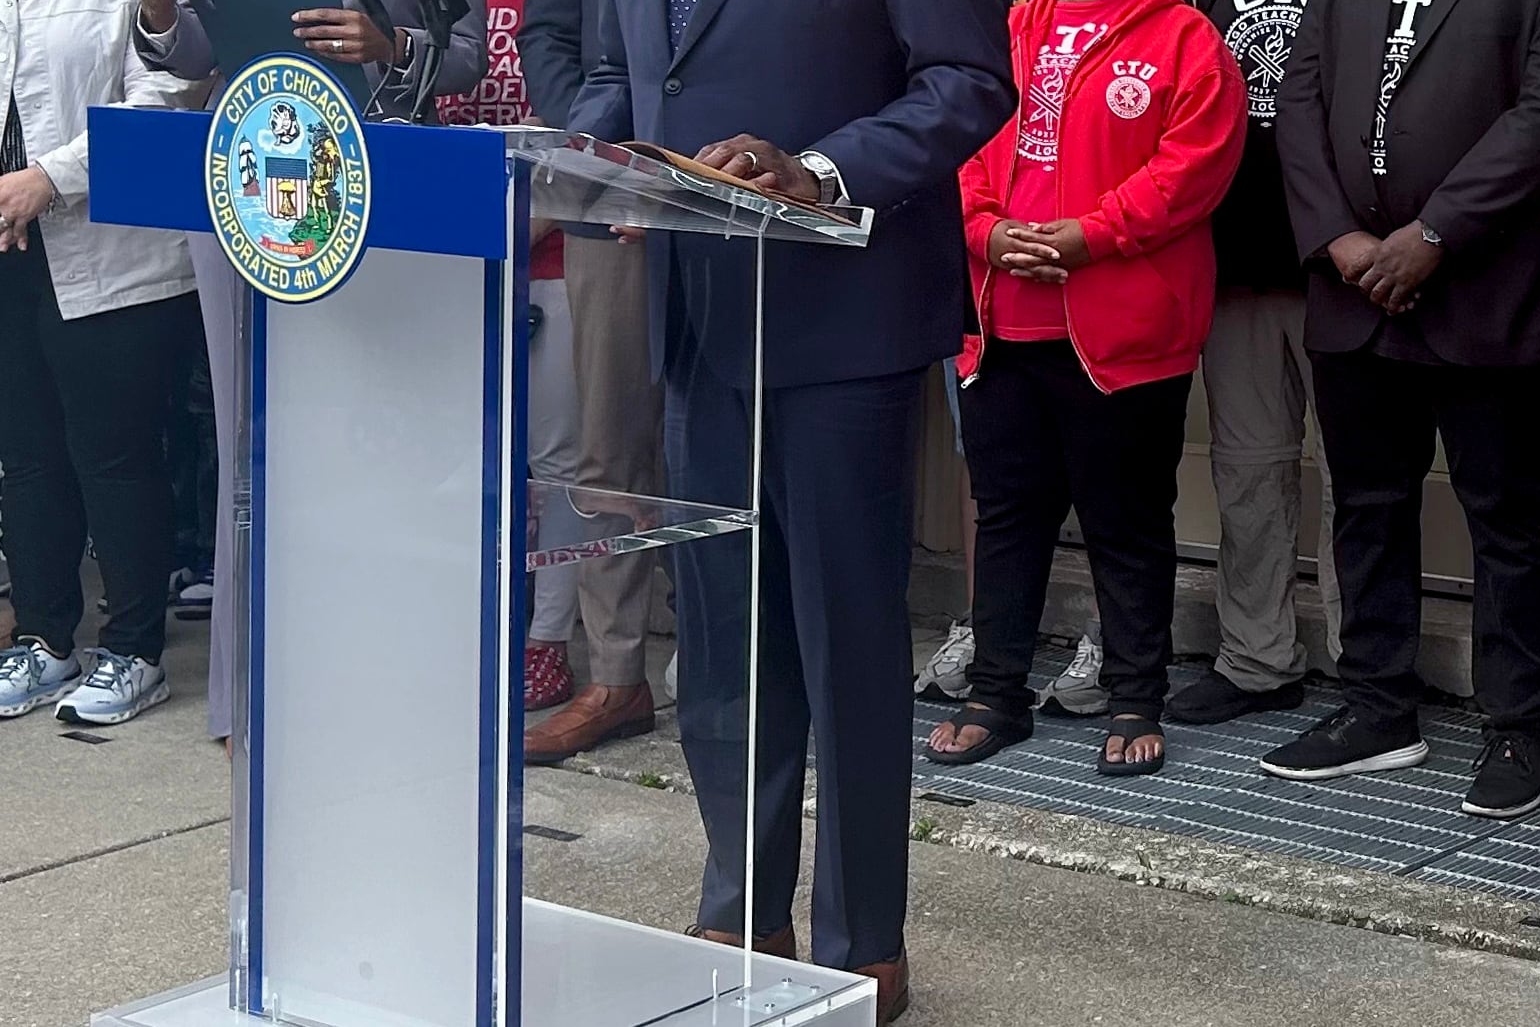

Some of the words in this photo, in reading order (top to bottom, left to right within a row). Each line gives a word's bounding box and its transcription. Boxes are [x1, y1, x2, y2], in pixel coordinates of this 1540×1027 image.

[226, 80, 254, 125] CITY
[258, 69, 278, 93] OF
[283, 69, 348, 135] CHICAGO
[1112, 60, 1158, 80] CTU
[211, 152, 290, 290] INCORPORATED
[294, 266, 318, 290] 4th
[322, 213, 361, 281] MARCH
[347, 158, 364, 205] 1837
